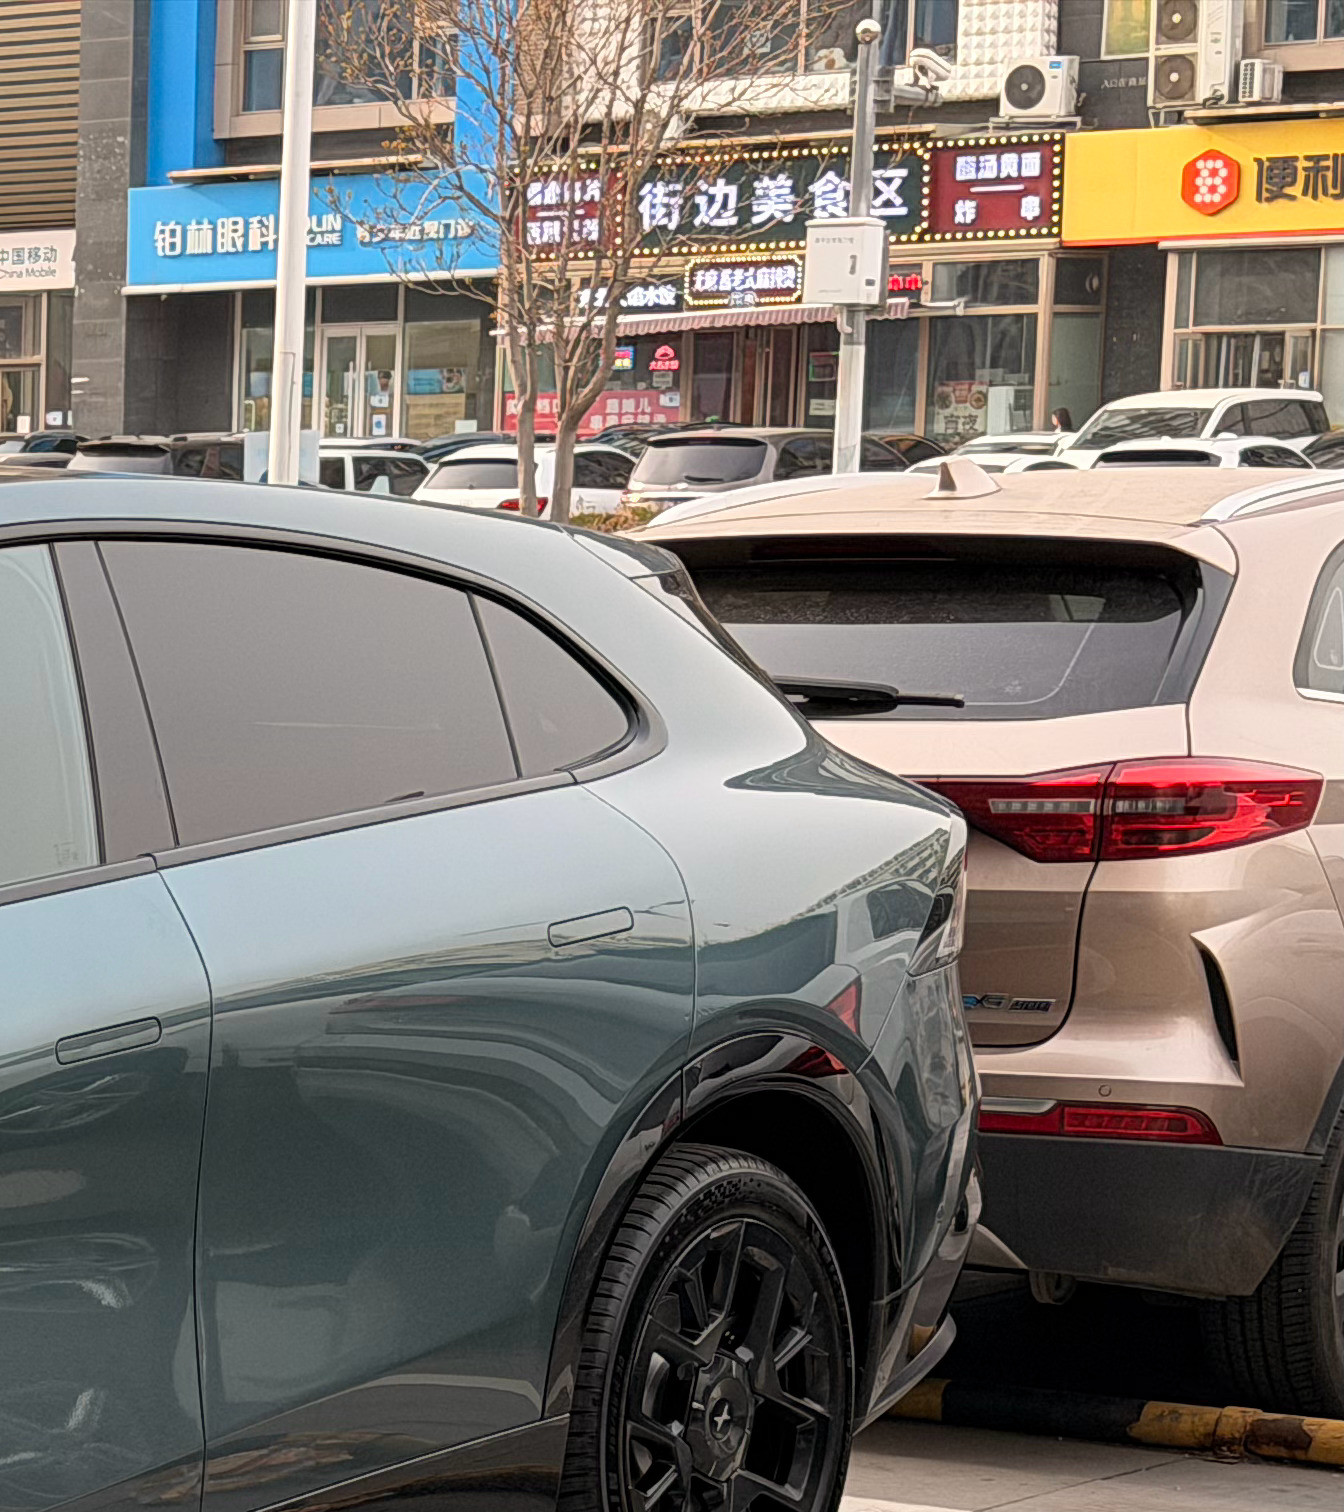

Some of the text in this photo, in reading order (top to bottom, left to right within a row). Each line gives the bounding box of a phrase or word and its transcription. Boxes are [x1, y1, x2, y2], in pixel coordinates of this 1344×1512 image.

[638, 168, 909, 231] 街边美食区
[154, 213, 277, 257] 铂林眼科
[25, 265, 57, 278] Mobile
